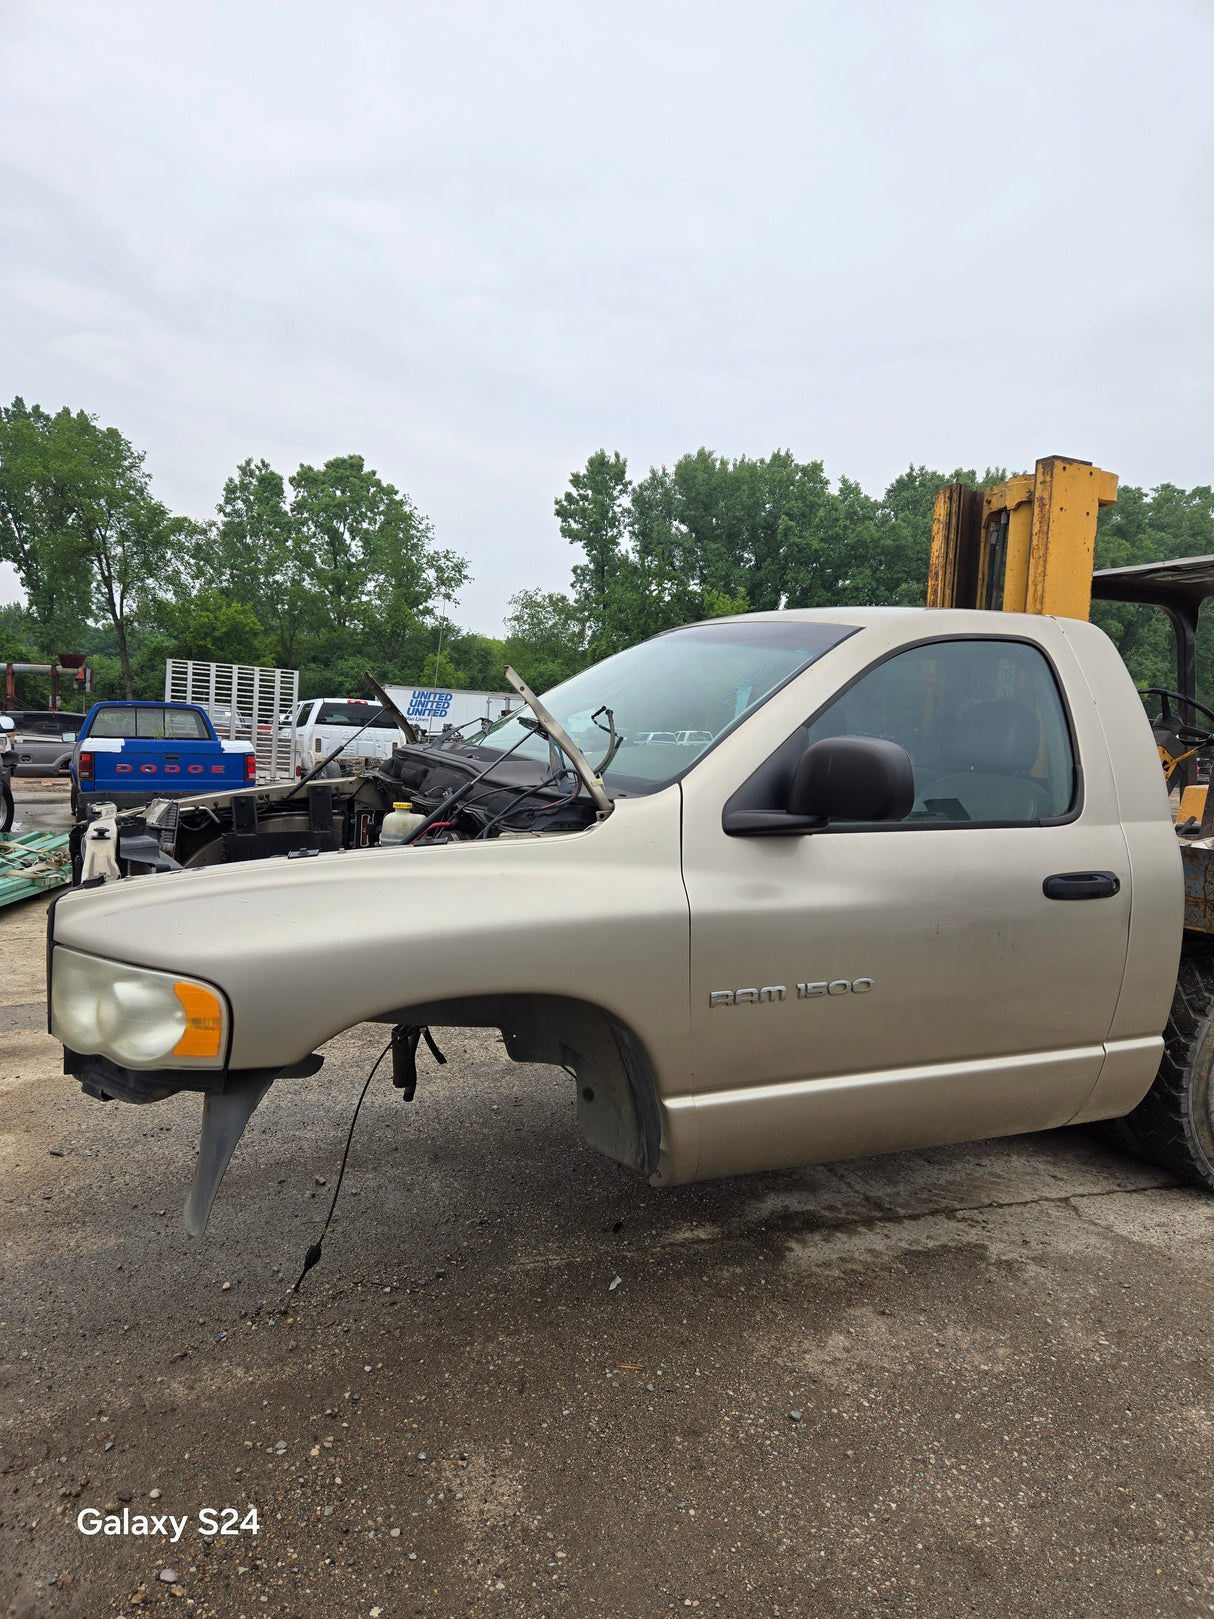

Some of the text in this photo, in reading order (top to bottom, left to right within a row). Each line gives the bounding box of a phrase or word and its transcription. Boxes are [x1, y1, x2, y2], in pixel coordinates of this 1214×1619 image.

[412, 690, 453, 701] UNITED
[409, 699, 451, 709] UNITED
[406, 707, 448, 718] UNITED
[116, 764, 226, 774] DODGE
[709, 977, 875, 1008] RAM 1500
